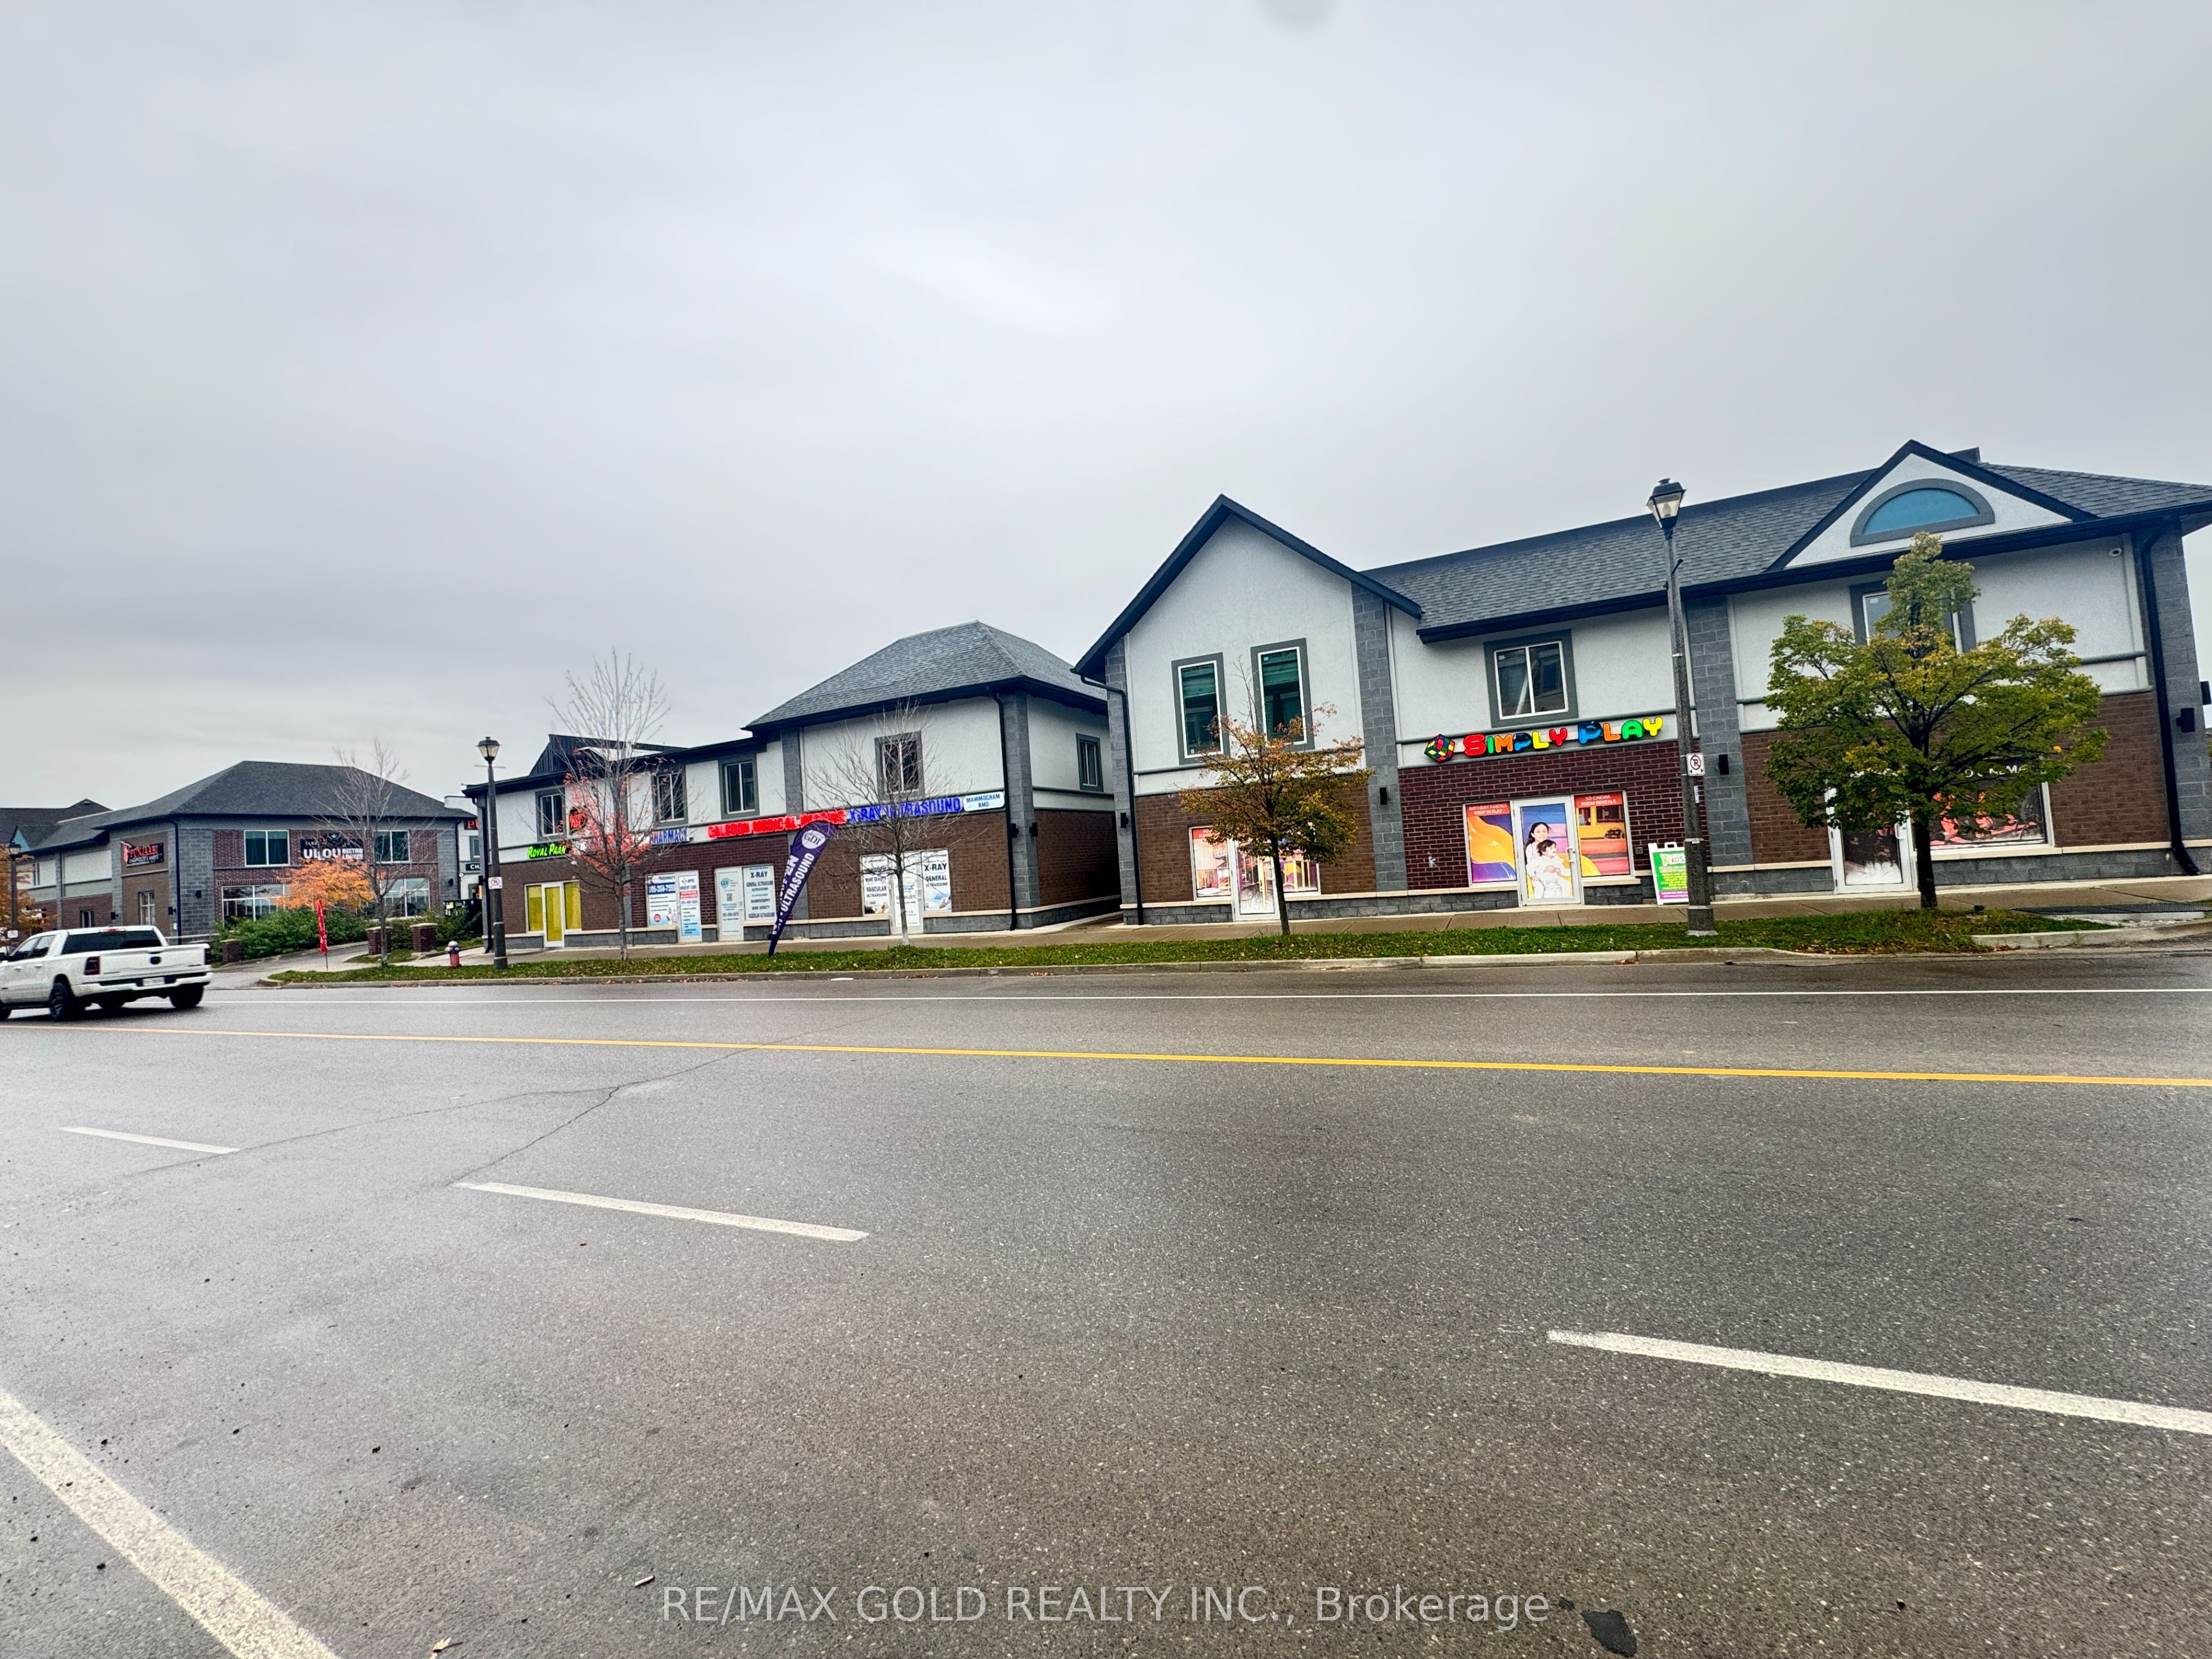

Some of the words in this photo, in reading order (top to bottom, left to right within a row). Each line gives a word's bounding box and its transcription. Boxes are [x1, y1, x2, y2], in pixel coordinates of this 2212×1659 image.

[1463, 727, 1568, 757] SIMPLY
[1578, 717, 1663, 745] PLAY
[966, 794, 1000, 803] MAMMOGRAM
[707, 821, 751, 839] CALEDON
[804, 833, 822, 845] GDI
[528, 846, 548, 857] ROYAL
[925, 863, 947, 872] X-RAY
[781, 853, 815, 912] ULTRASOUND
